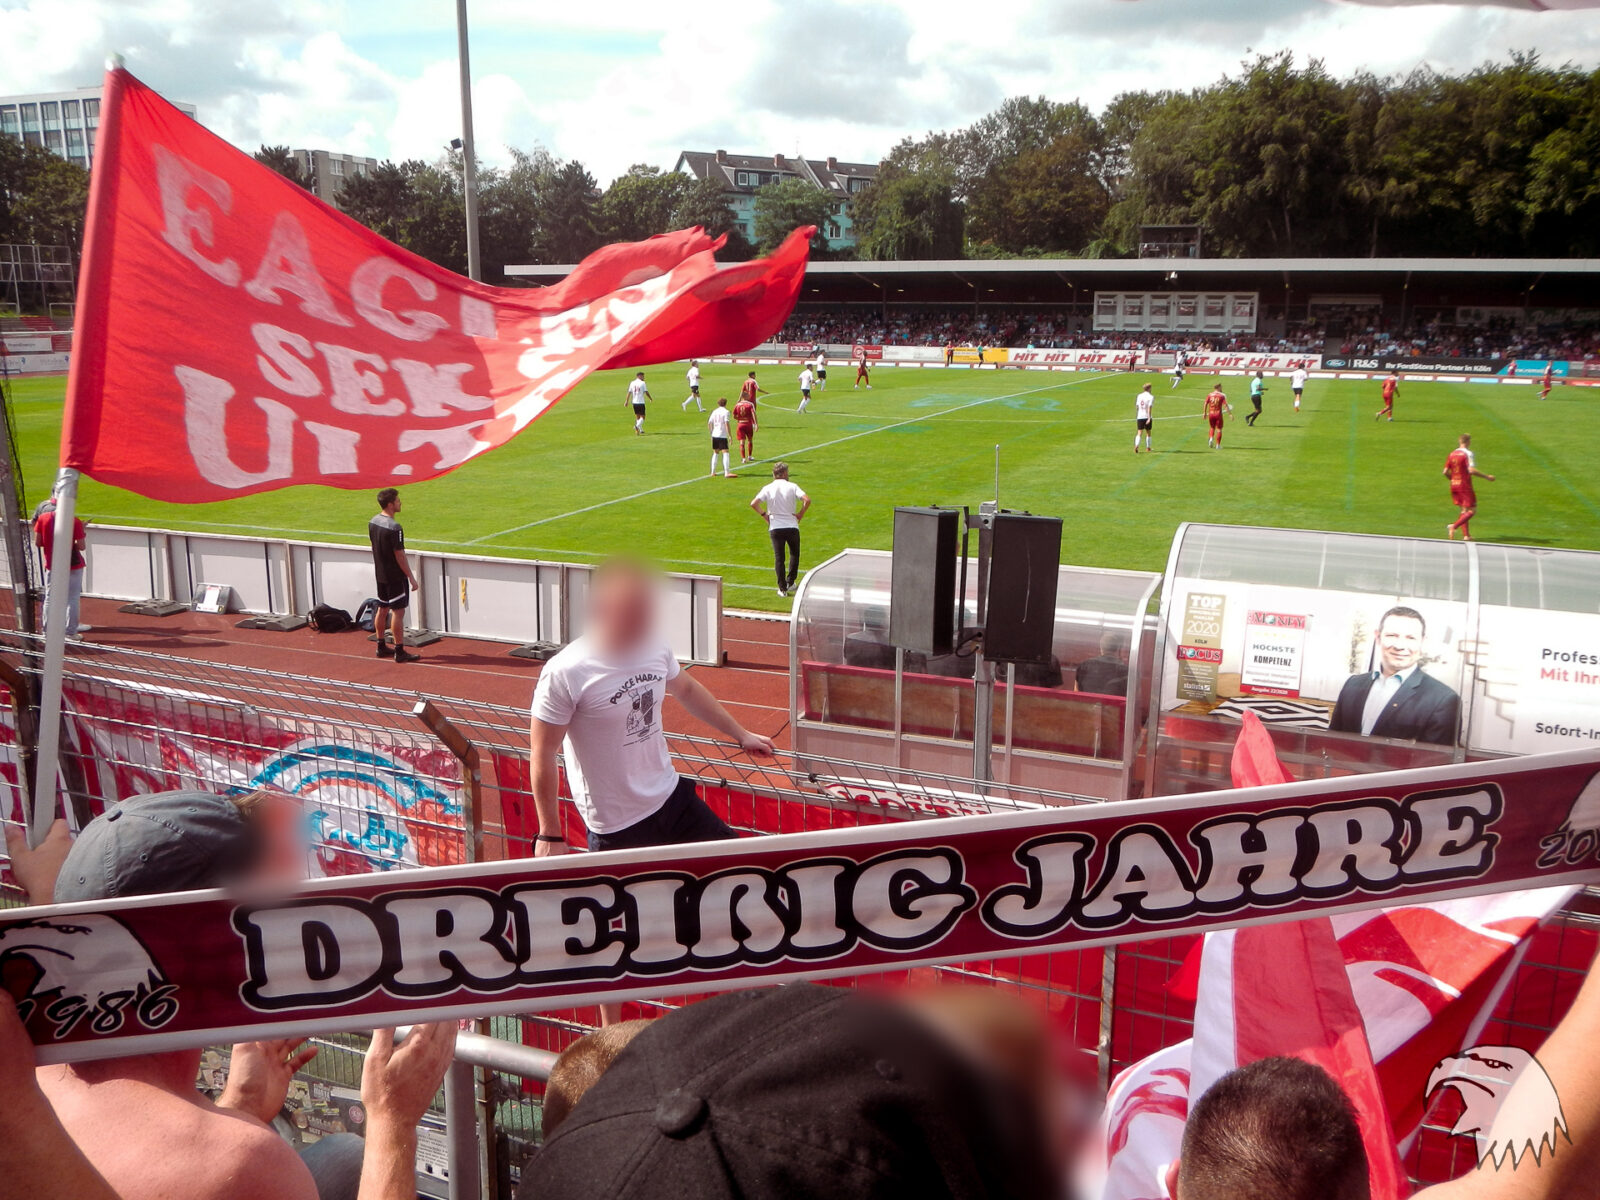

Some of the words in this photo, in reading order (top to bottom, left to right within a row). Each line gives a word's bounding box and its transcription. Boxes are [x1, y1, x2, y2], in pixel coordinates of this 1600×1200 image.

[1014, 353, 1039, 362] HIT
[1043, 353, 1071, 362] HIT
[1078, 354, 1108, 363] HIT
[1213, 356, 1244, 368] HIT
[1248, 357, 1280, 369] HIT
[1353, 359, 1379, 369] R&S
[1190, 595, 1223, 608] TOP
[1252, 611, 1304, 627] MONEY
[1186, 620, 1220, 635] 2020
[1179, 647, 1221, 661] FOCUS
[1253, 655, 1292, 667] KOMPETENZ
[1542, 648, 1600, 665] Profes
[1540, 667, 1568, 682] Mit
[1574, 671, 1600, 685] Ihr
[610, 678, 635, 705] POLICE
[1536, 827, 1600, 869] 20
[982, 783, 1504, 939] JAHRE
